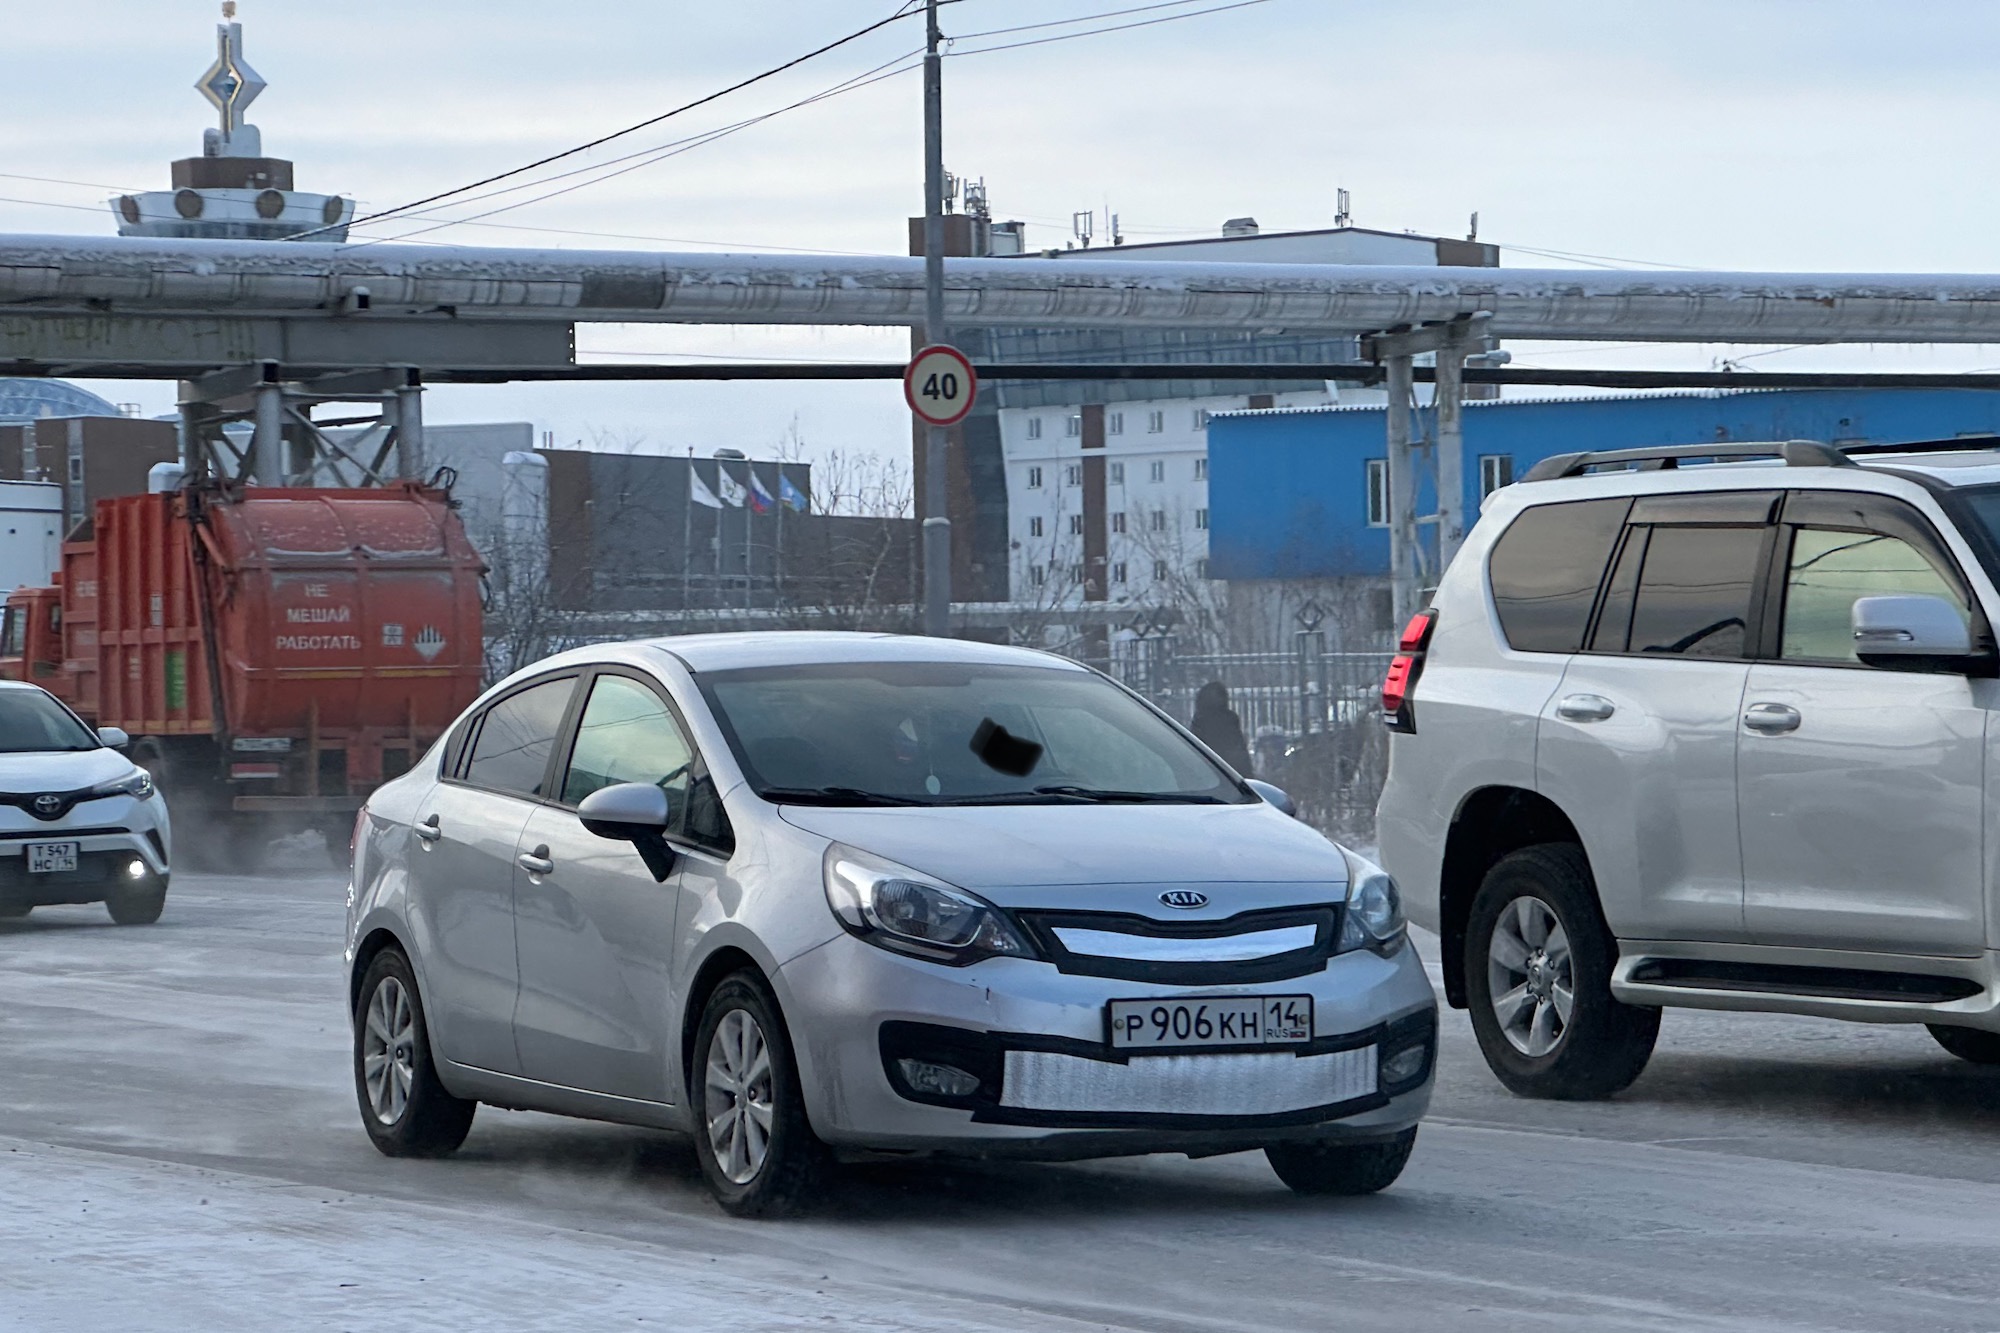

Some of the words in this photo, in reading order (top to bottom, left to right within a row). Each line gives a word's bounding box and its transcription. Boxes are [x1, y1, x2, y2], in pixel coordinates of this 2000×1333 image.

[922, 373, 958, 400] 40
[304, 584, 329, 598] НЕ
[287, 606, 351, 623] МЕШАЙ
[275, 635, 362, 650] РАБОТАТЬ
[1166, 892, 1203, 904] KIA
[1270, 1001, 1299, 1028] 14
[1266, 1028, 1289, 1039] RUS
